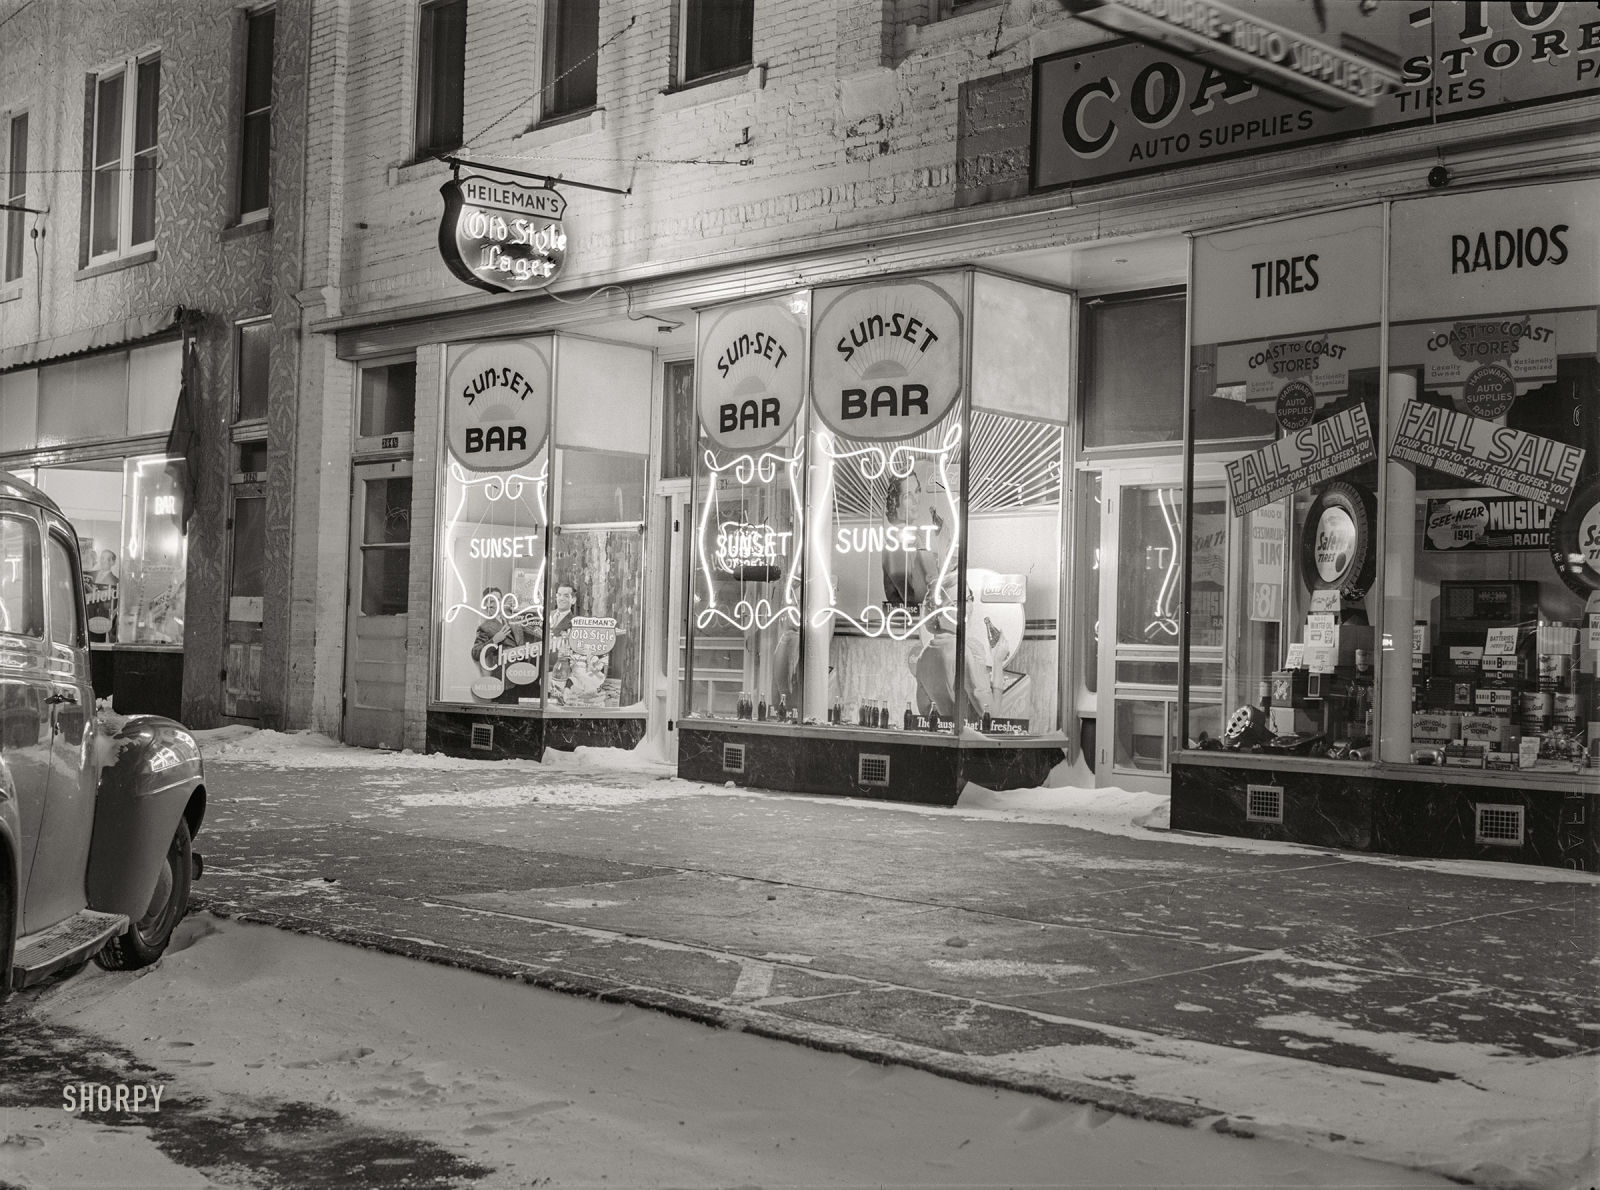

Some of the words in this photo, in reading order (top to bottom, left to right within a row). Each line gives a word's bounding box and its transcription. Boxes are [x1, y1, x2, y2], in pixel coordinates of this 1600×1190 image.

[1394, 78, 1486, 113] TIRES
[1129, 133, 1191, 162] AUTO
[1199, 110, 1314, 149] SUPPLIES
[467, 184, 559, 213] HEILEMAN'S
[461, 211, 508, 241] Old
[509, 218, 567, 256] Style
[475, 244, 555, 281] Lager
[1451, 224, 1569, 275] RADIOS
[1251, 253, 1320, 299] TIRES
[1427, 325, 1476, 351] COAST
[1481, 325, 1496, 335] TO
[1501, 321, 1554, 343] COAST
[1459, 340, 1520, 358] STORES
[1248, 343, 1287, 369] COAST
[1290, 343, 1301, 352] TO
[1304, 340, 1347, 360] COAST
[1272, 357, 1320, 374] STORES
[1469, 368, 1511, 387] HARDWARE
[1476, 384, 1503, 393] AUTO
[841, 384, 929, 420] BAR
[1279, 383, 1313, 401] HARDWARE
[1285, 398, 1306, 406] AUTO
[1466, 392, 1513, 402] SUPPLIES
[720, 397, 780, 433] BAR
[1277, 407, 1314, 417] SUPPLIES
[1282, 417, 1309, 430] RADIOS
[1472, 404, 1506, 417] RADIOS
[465, 425, 527, 454] BAR
[1226, 442, 1291, 497] FALL
[1296, 405, 1369, 464] SALE
[1400, 399, 1475, 453] FALL
[1489, 427, 1580, 486] SALE
[1234, 492, 1253, 505] YOUR
[1308, 457, 1330, 473] STORE
[1331, 447, 1355, 462] OFFERS
[1355, 440, 1370, 453] YOU
[1396, 436, 1420, 451] YOUR
[1490, 465, 1518, 480] STORE
[1519, 473, 1549, 489] OFFERS
[1550, 483, 1568, 495] YOU
[154, 495, 177, 515] BAR
[1429, 506, 1485, 529] SEE-HEAR
[469, 535, 538, 559] SUNSET
[716, 531, 792, 559] SUNSET
[835, 525, 939, 554] SUNSET
[1454, 530, 1474, 541] 1941
[1317, 553, 1336, 563] TIRES
[571, 629, 588, 640] Old
[589, 629, 615, 644] Style
[573, 619, 616, 628] HEILEMAN'S
